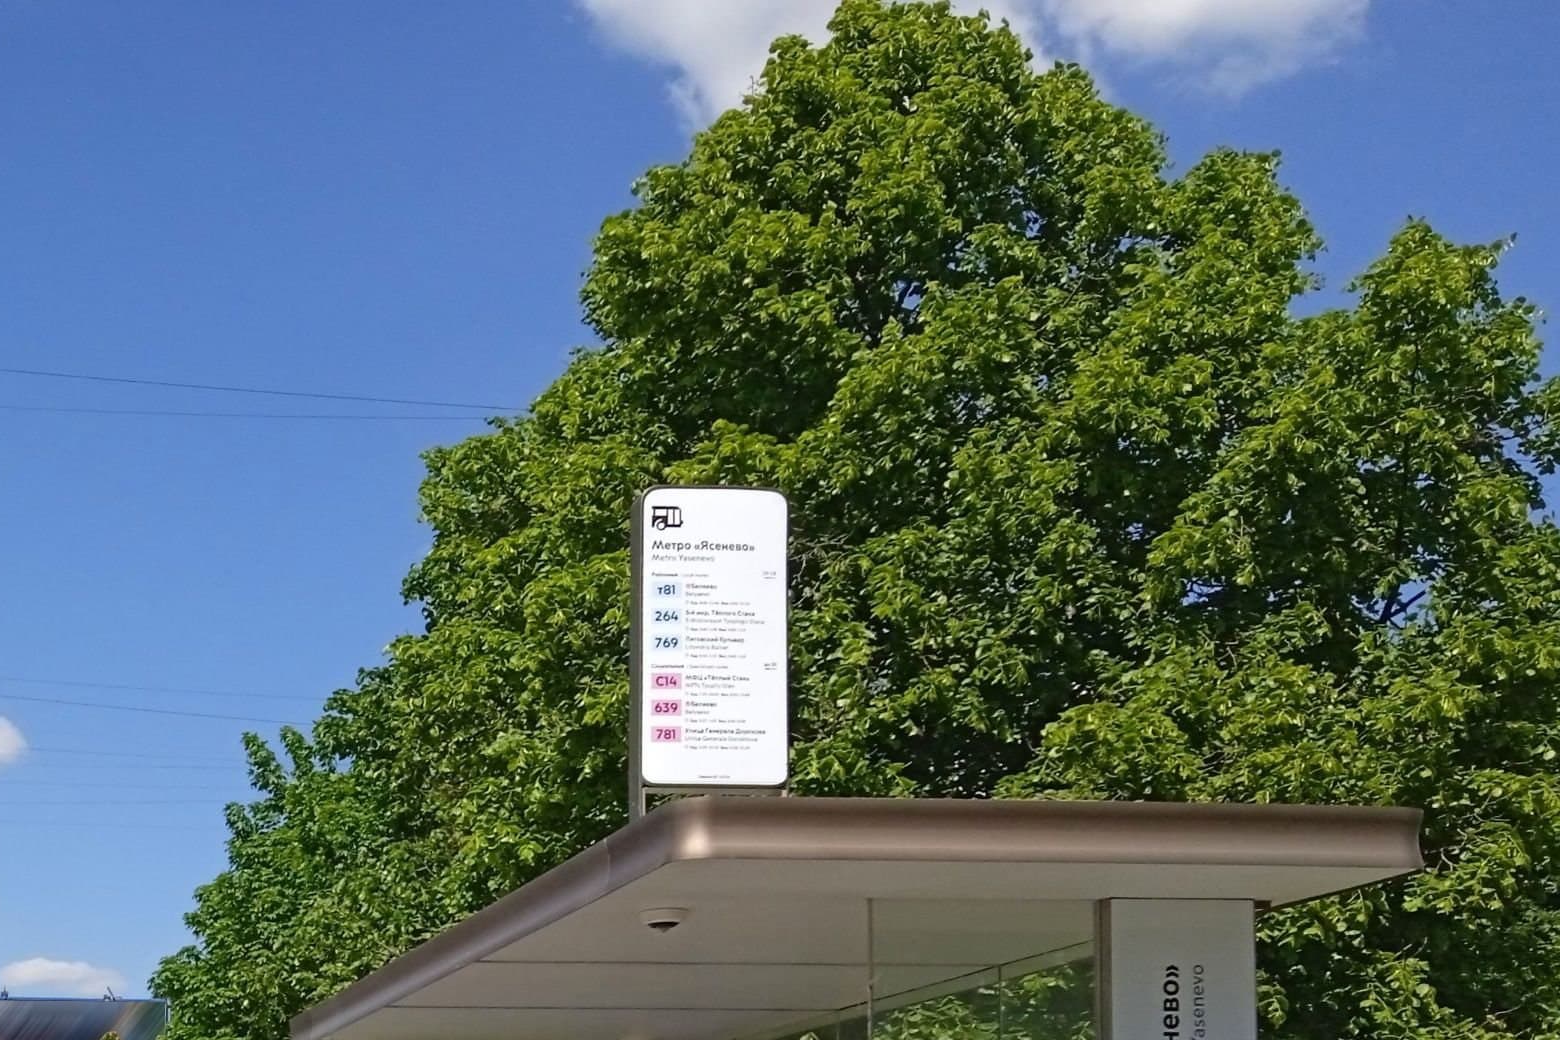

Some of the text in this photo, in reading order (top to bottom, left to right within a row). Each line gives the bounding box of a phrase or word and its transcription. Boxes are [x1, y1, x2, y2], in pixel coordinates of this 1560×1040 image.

[651, 540, 755, 552] Метро «Ясенево»
[655, 611, 678, 622] 264
[654, 637, 678, 648] 769
[655, 676, 677, 686] С14
[654, 702, 678, 713] 639
[656, 729, 676, 740] 781
